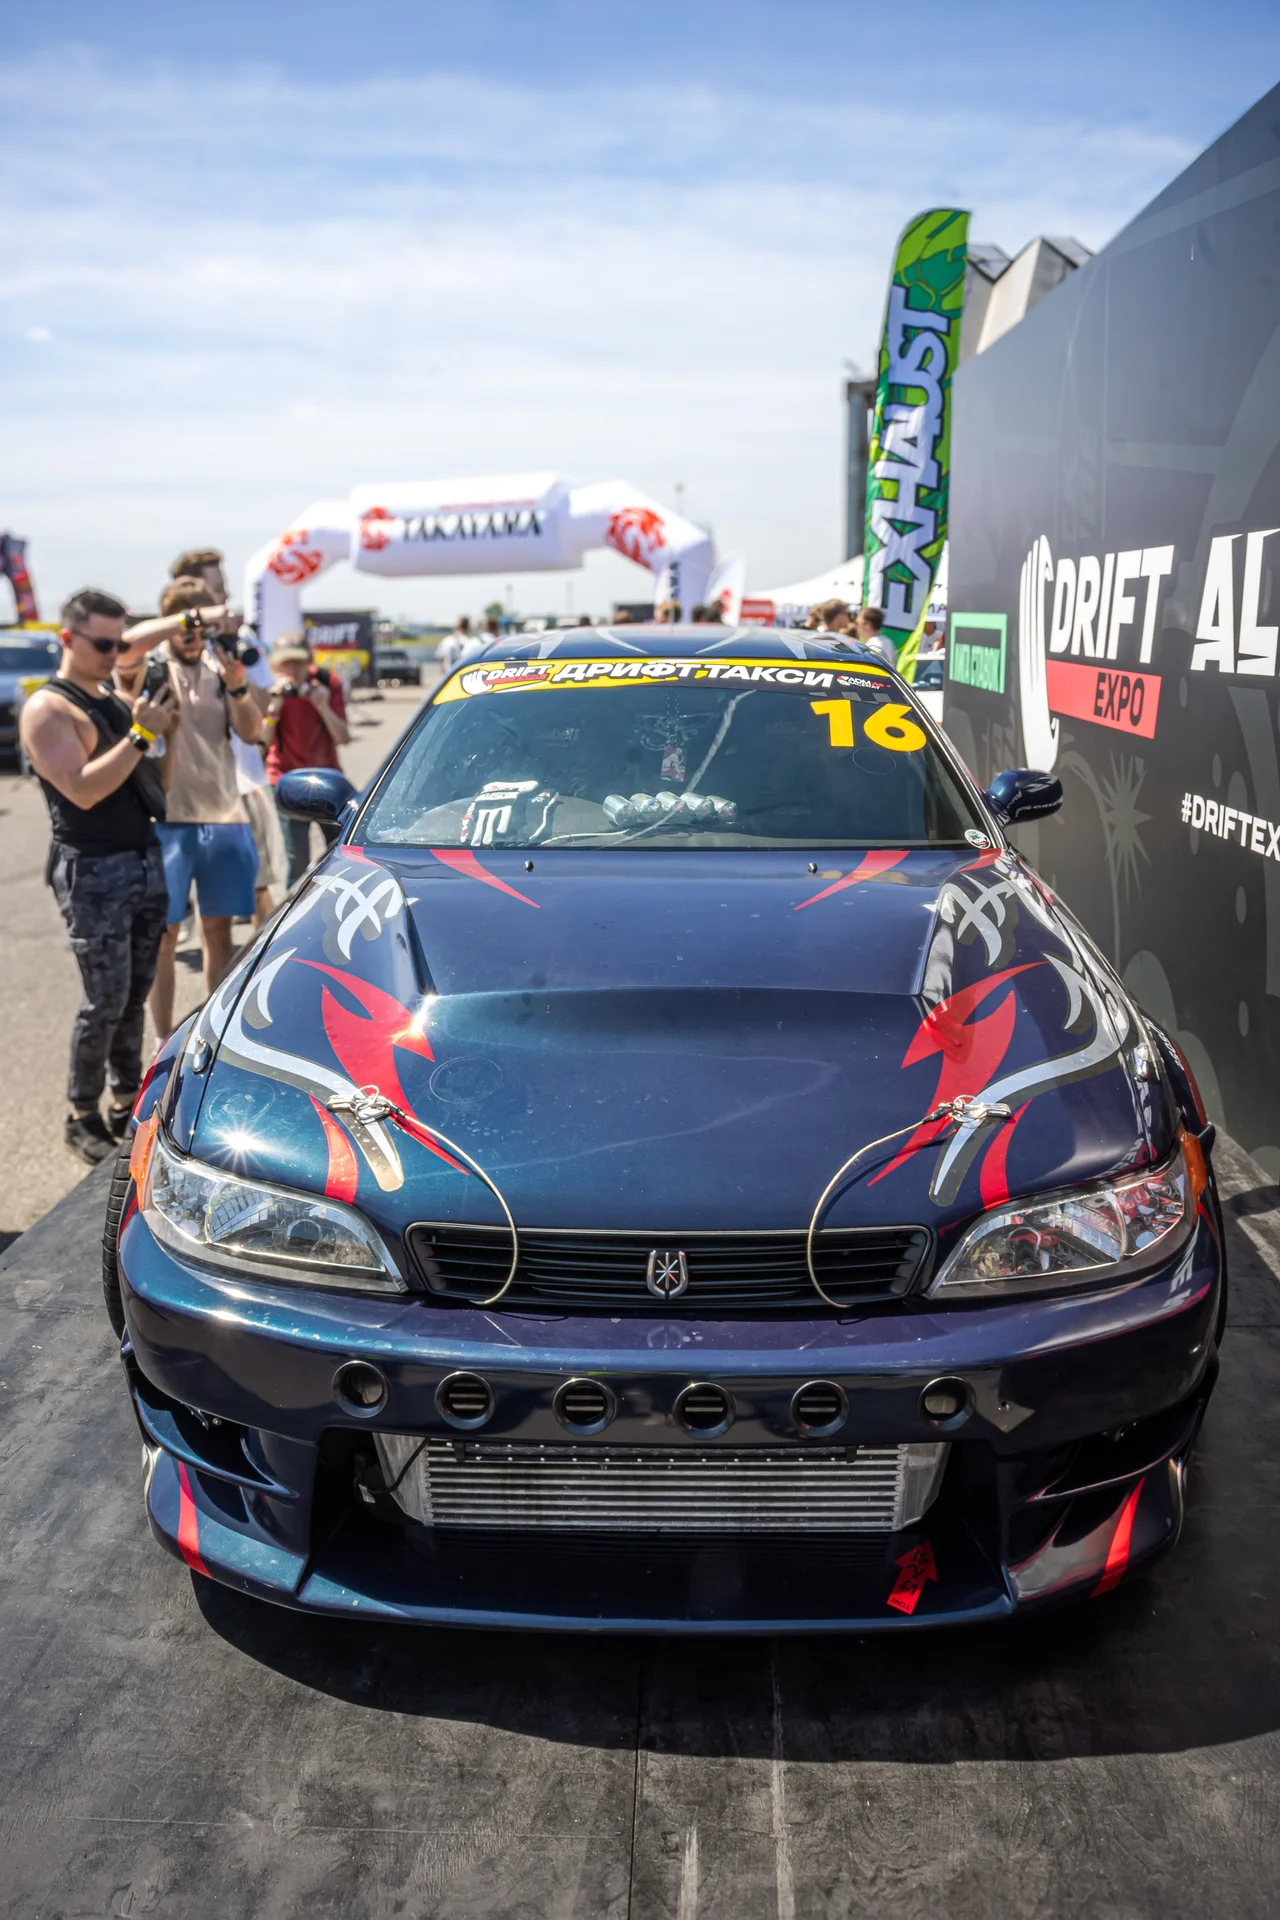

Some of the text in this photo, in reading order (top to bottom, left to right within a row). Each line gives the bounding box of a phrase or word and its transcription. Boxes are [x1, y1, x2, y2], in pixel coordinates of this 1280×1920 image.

[867, 284, 950, 632] EXHAUST
[1050, 544, 1175, 664] DRIFT
[1190, 528, 1280, 677] AL
[486, 664, 553, 680] DRIFT
[552, 661, 834, 688] ДРИФТ ТАКСИ
[1093, 672, 1146, 727] EXPO
[810, 700, 927, 752] 16
[1181, 792, 1280, 862] #DRIFTEX
[891, 1598, 911, 1611] TOW
